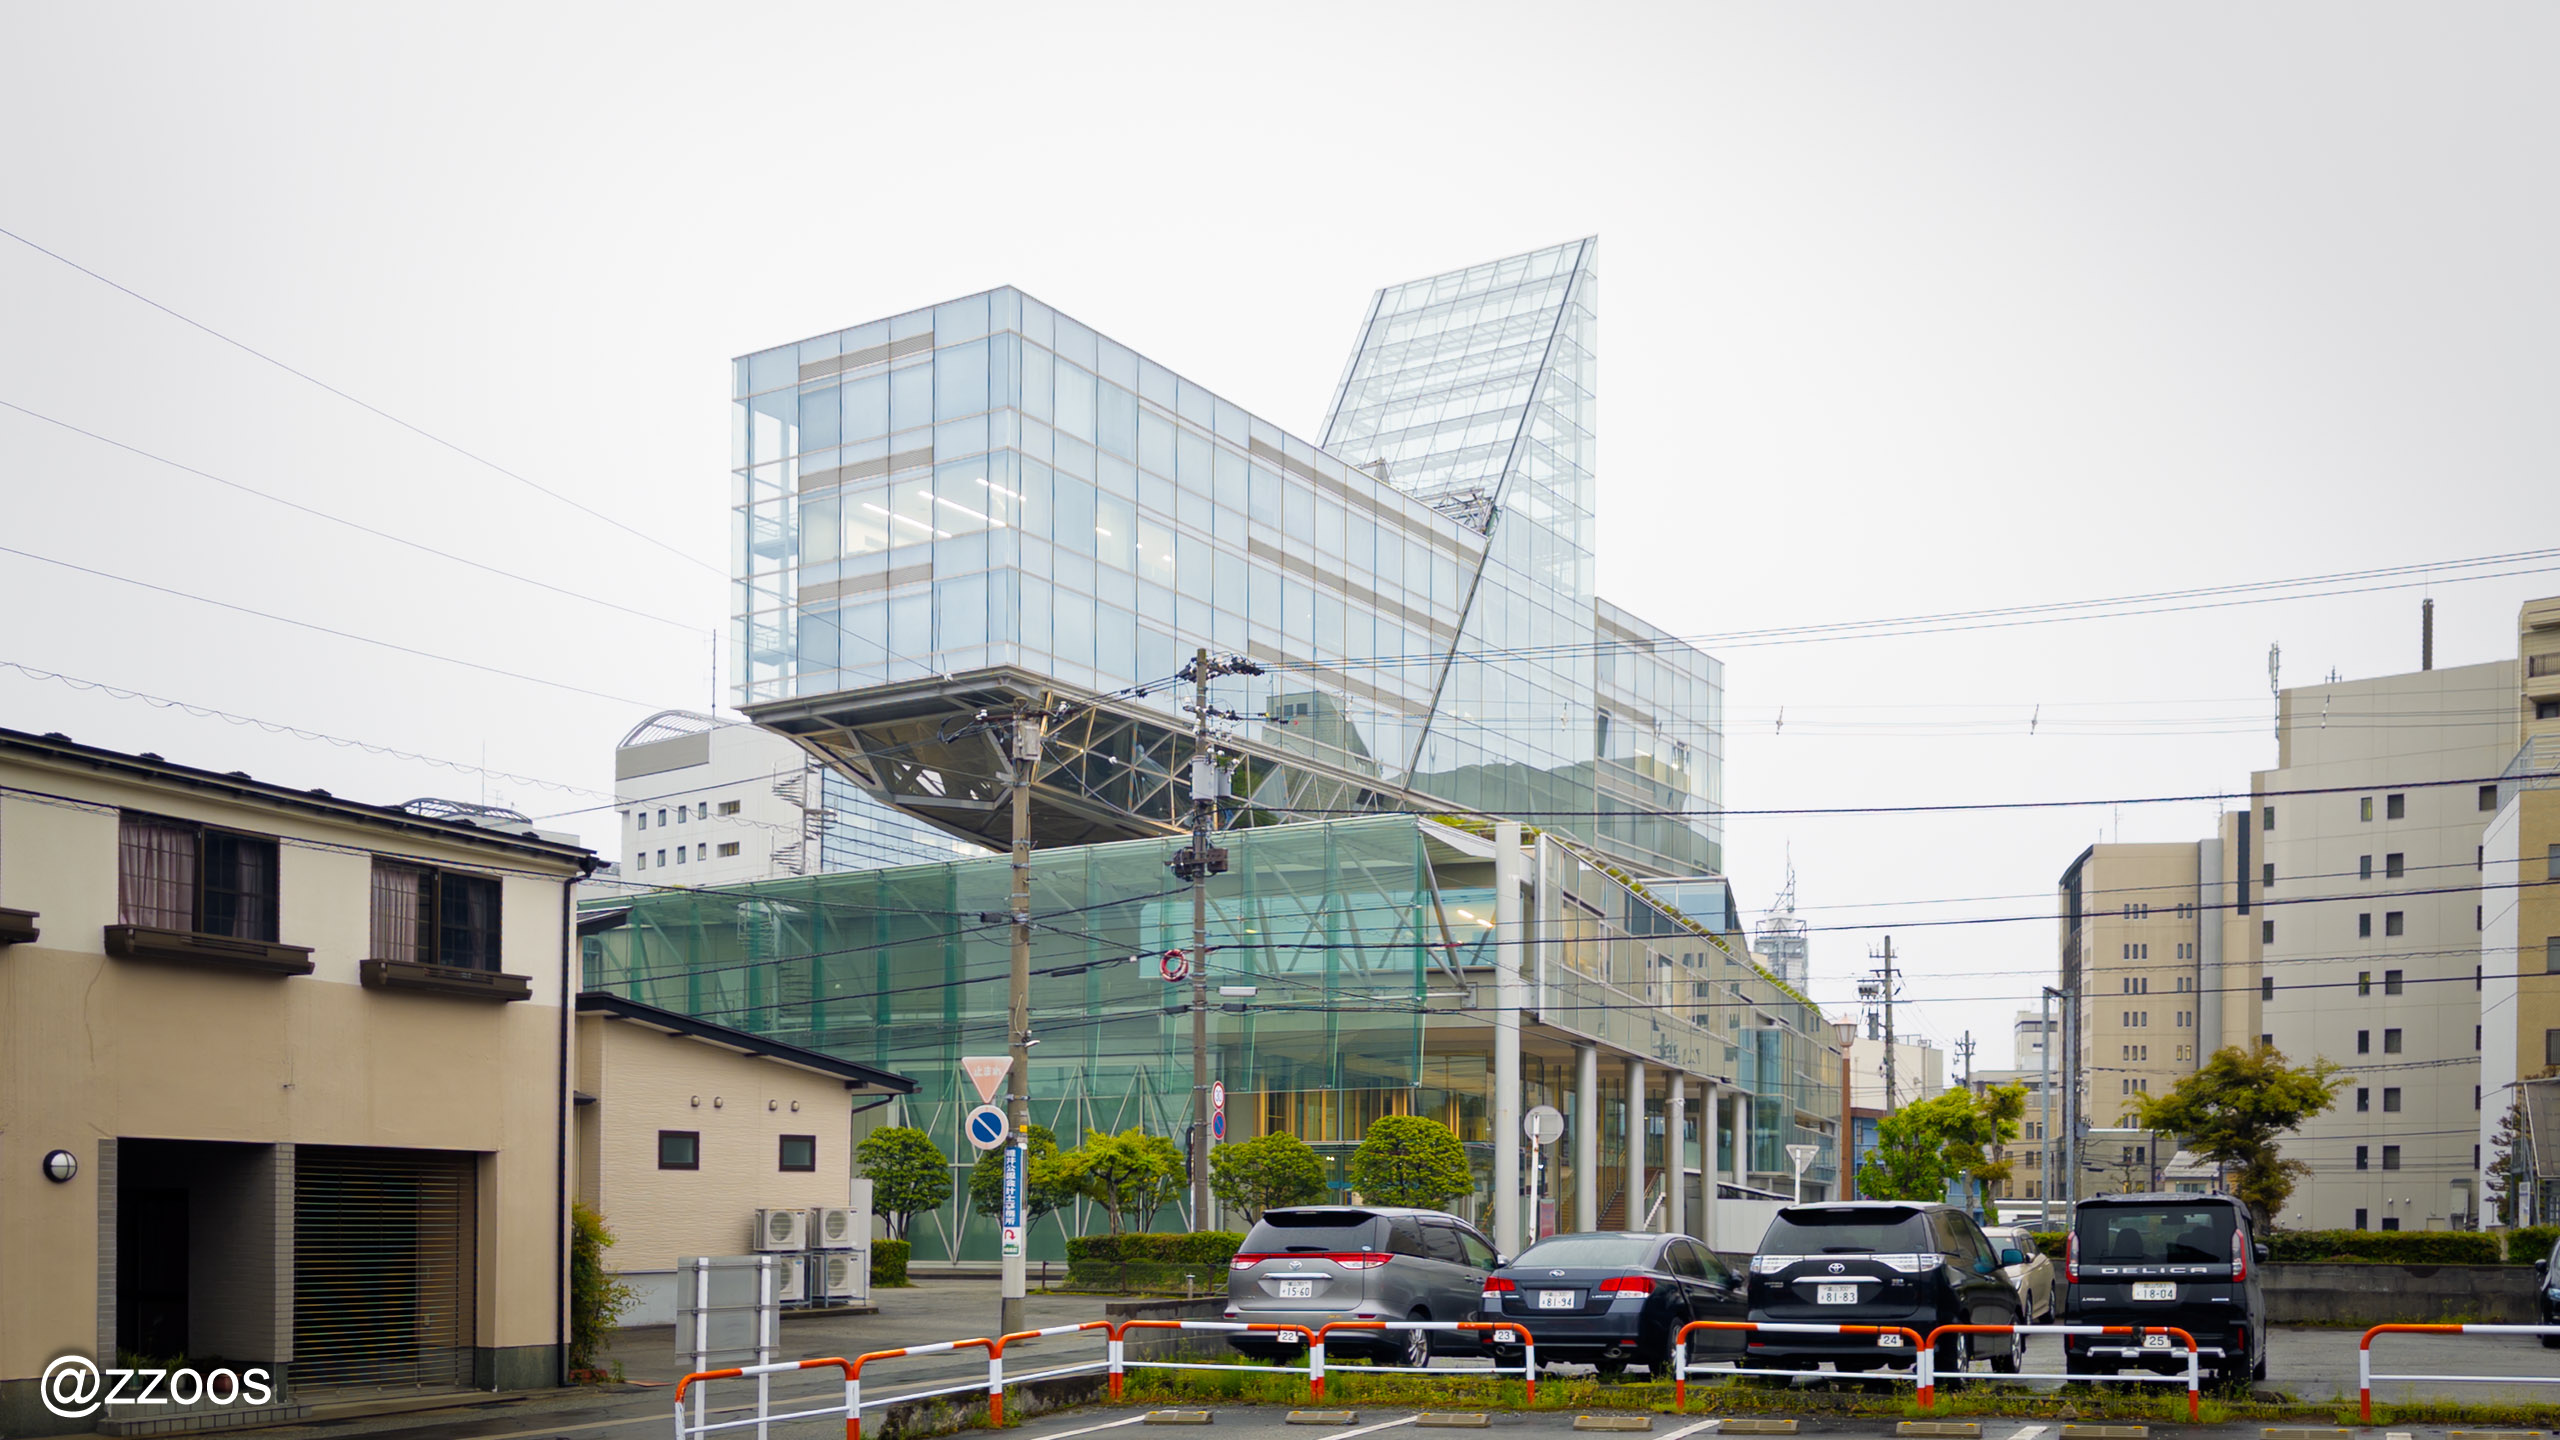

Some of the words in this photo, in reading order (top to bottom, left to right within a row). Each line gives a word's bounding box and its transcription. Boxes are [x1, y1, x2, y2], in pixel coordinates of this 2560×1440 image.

[974, 1065, 1003, 1077] 止まれ
[1826, 1292, 1855, 1302] 81-83
[2143, 1289, 2173, 1299] 18-04
[1282, 1332, 1294, 1341] 22
[1498, 1331, 1510, 1340] 23
[1883, 1335, 1897, 1345] 24
[2149, 1336, 2165, 1346] 25
